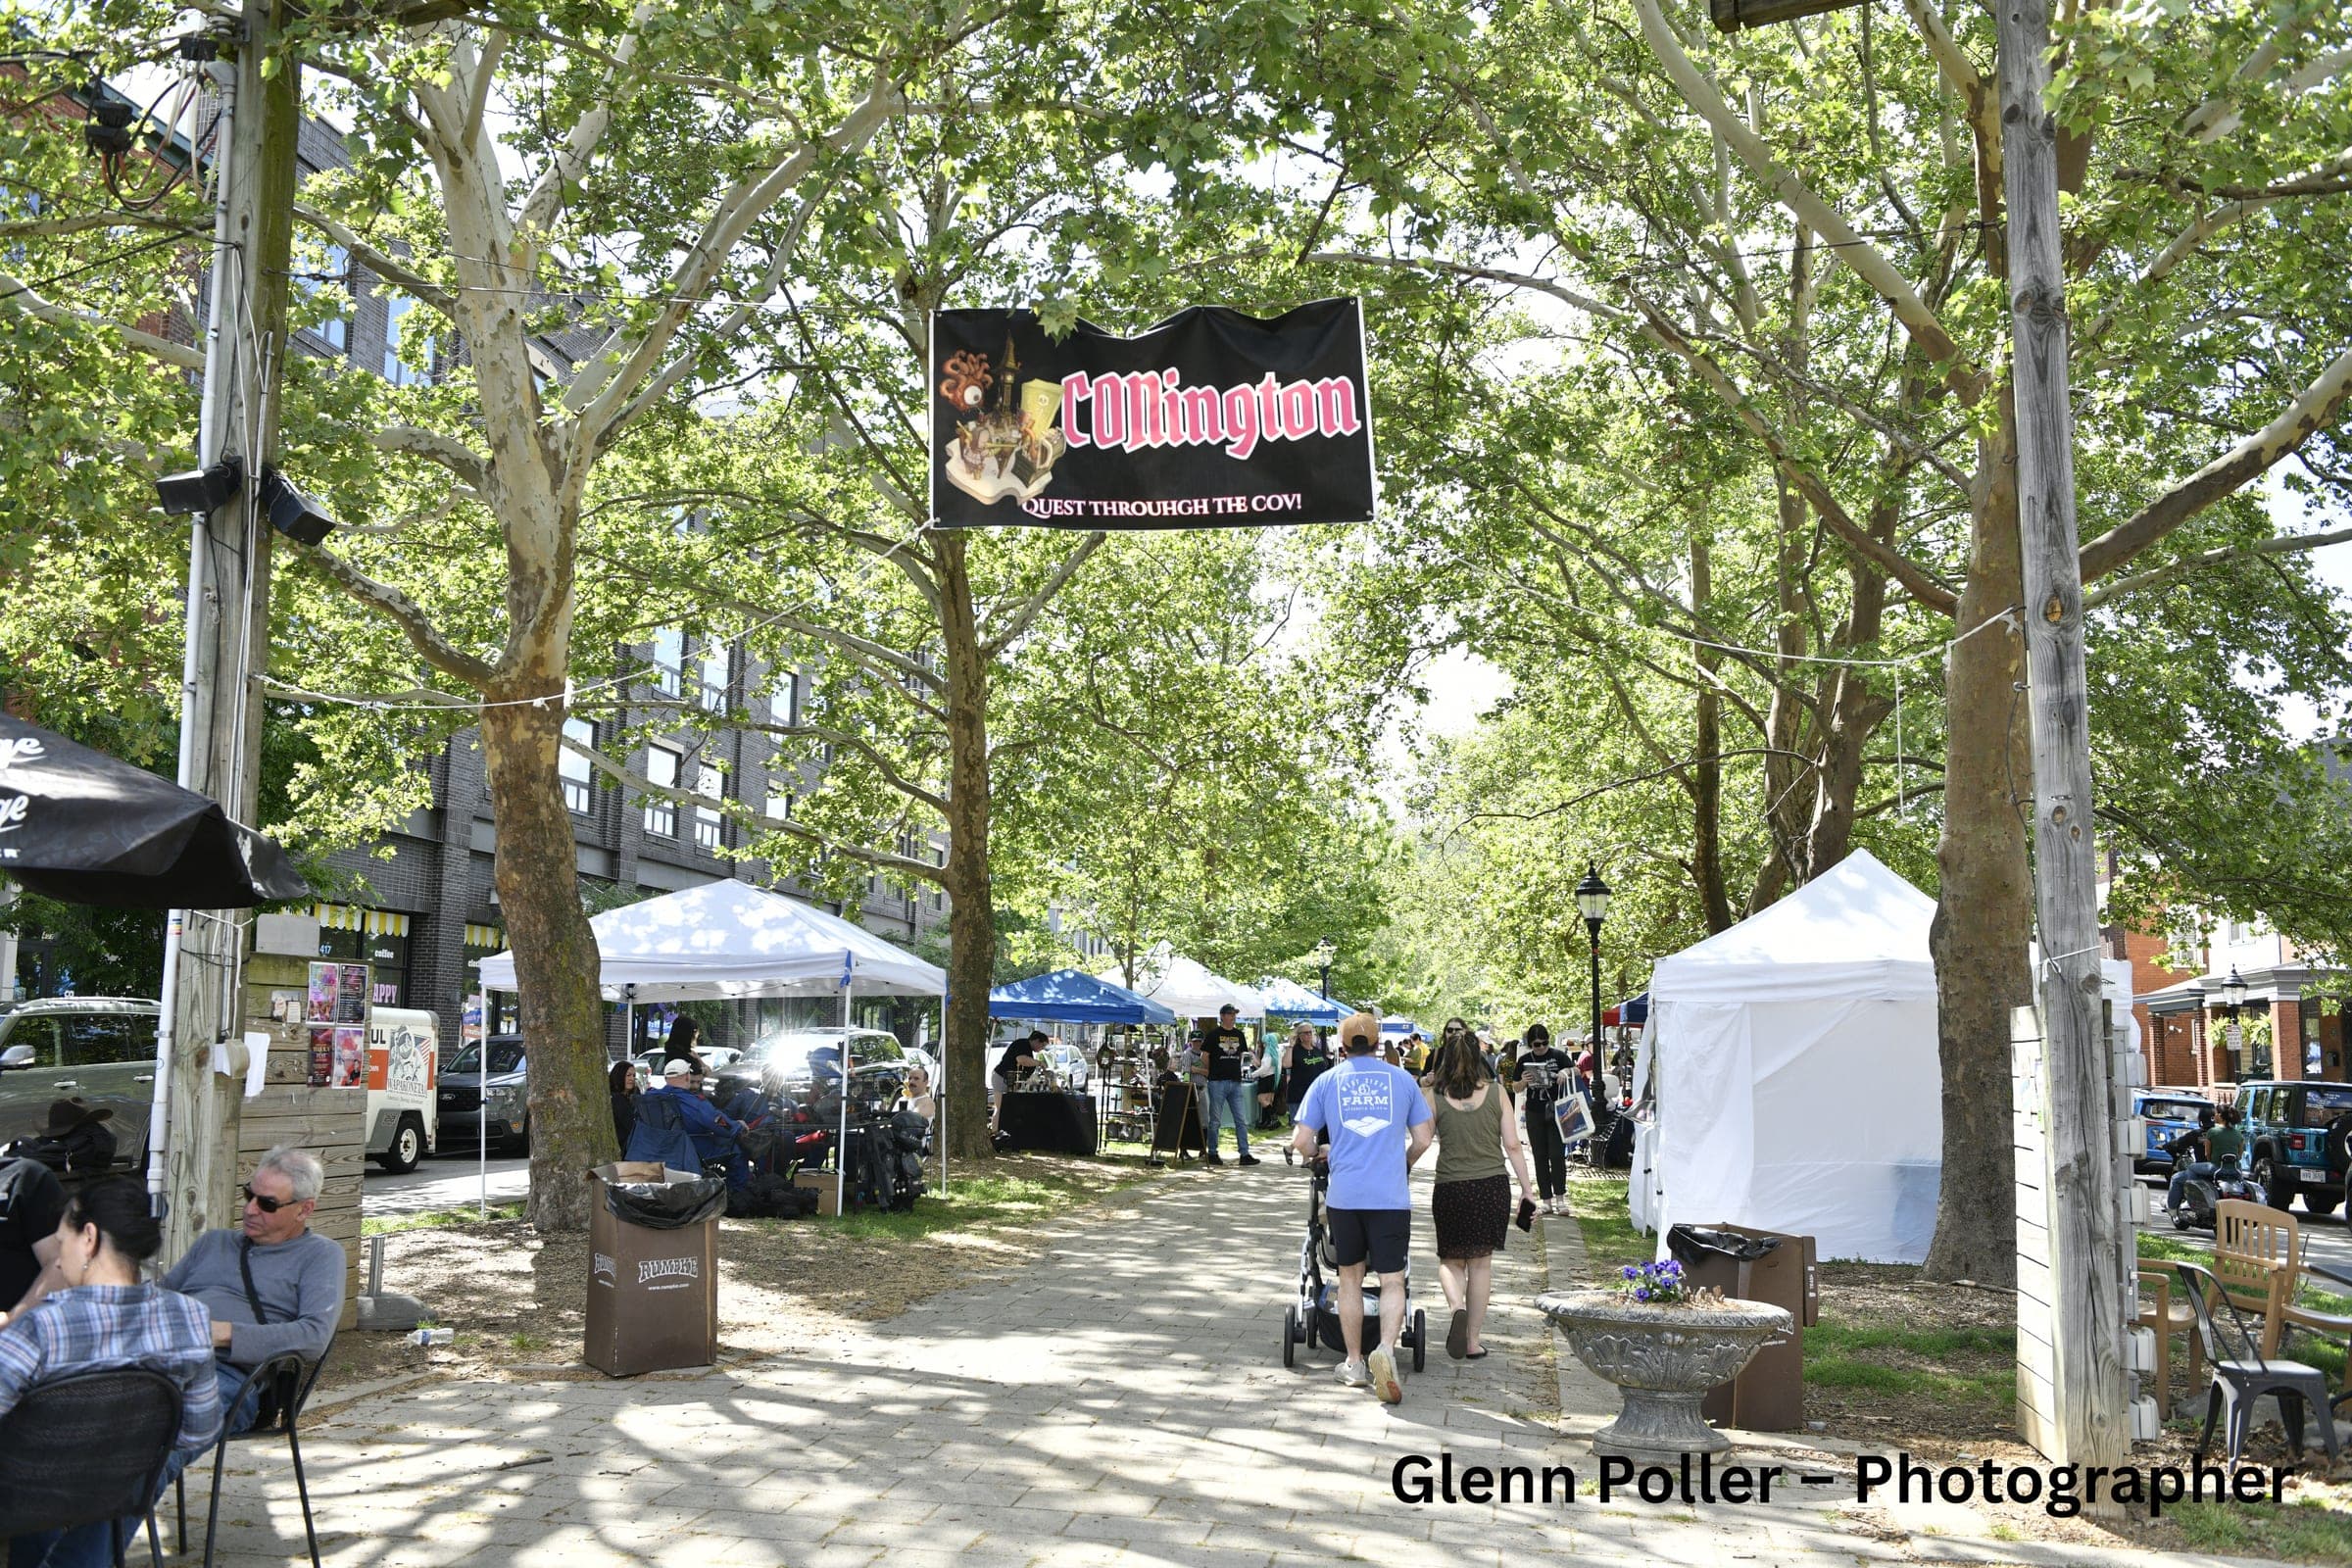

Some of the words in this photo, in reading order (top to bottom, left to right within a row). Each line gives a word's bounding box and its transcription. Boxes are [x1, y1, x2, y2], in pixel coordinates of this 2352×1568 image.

[1022, 498, 1086, 519] QUEST
[1089, 498, 1209, 516] THROUHGH
[1212, 495, 1249, 514] THE
[1250, 493, 1302, 512] COV!
[374, 948, 394, 959] coffee
[1342, 1096, 1389, 1105] FARM
[639, 1256, 698, 1283] RUMPKE
